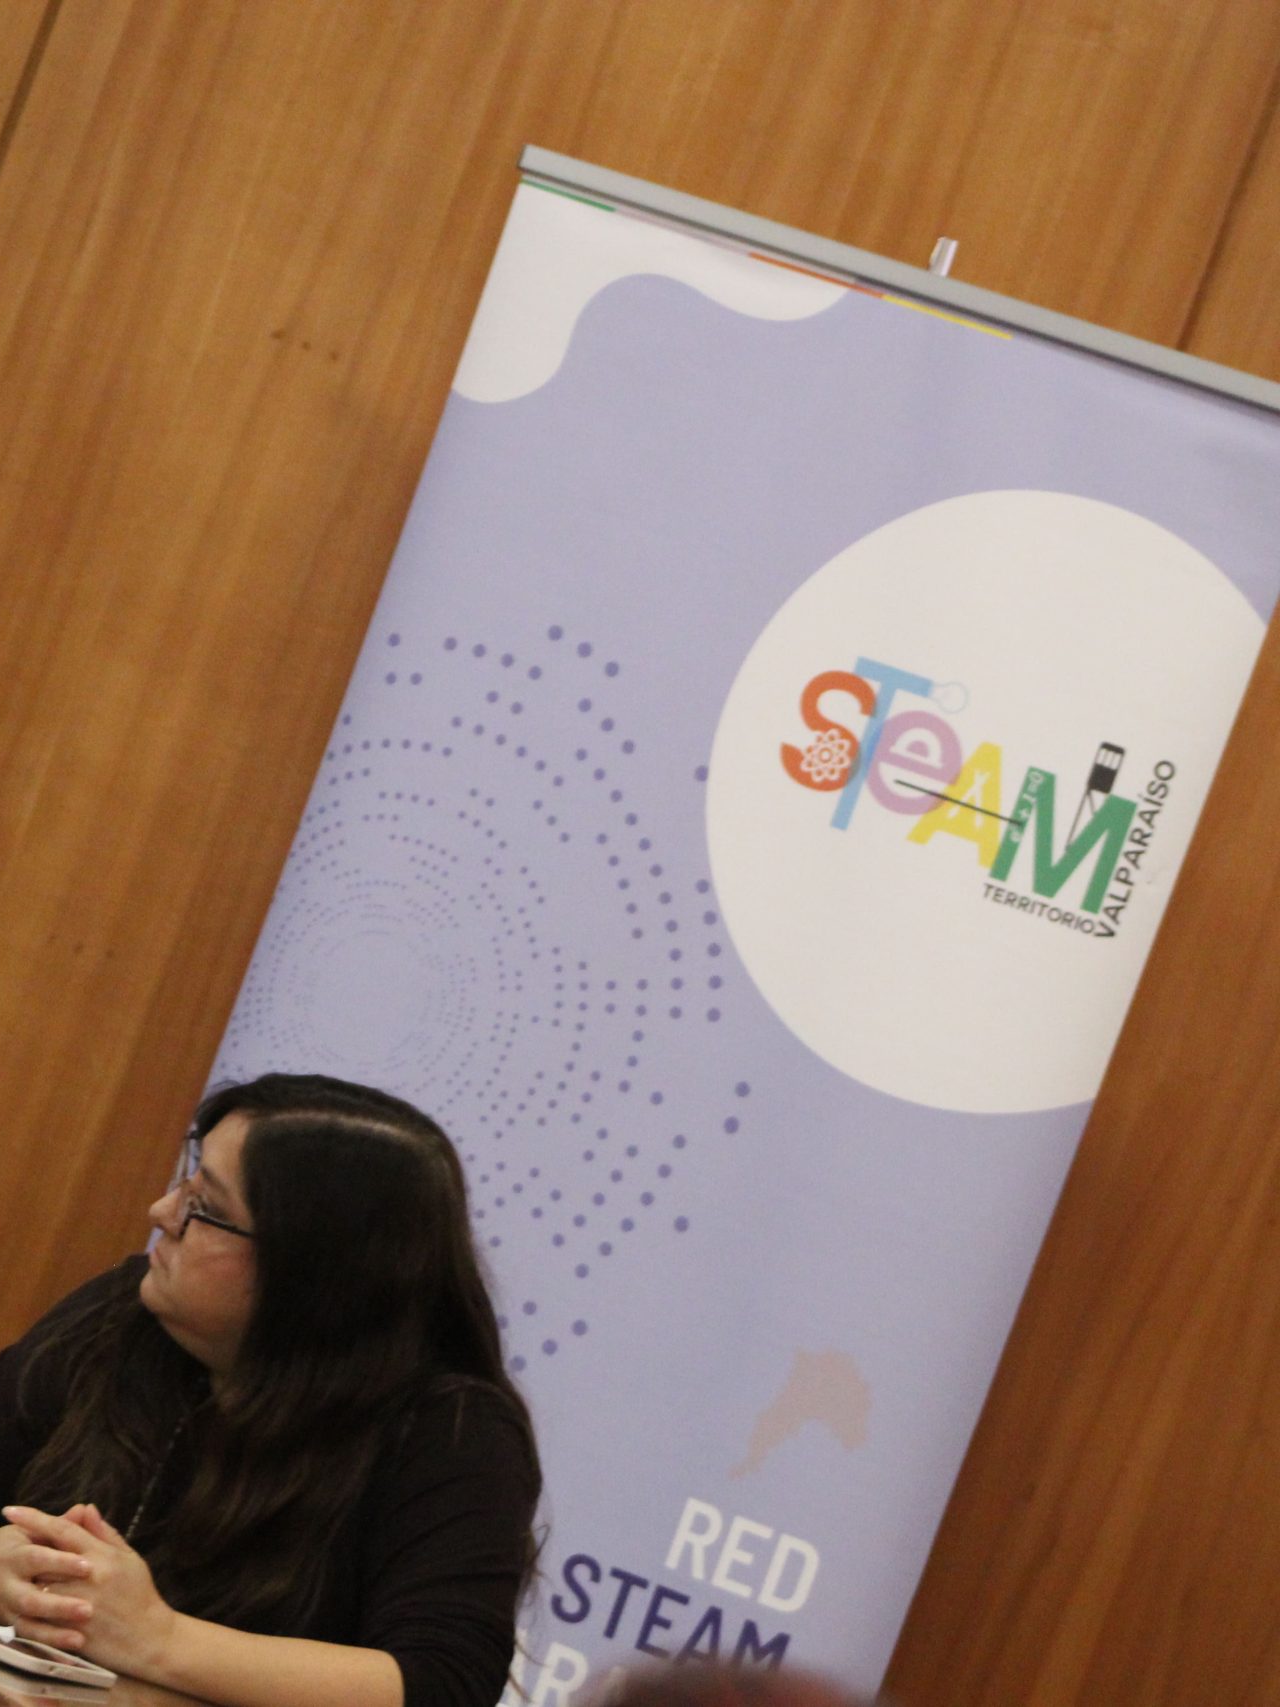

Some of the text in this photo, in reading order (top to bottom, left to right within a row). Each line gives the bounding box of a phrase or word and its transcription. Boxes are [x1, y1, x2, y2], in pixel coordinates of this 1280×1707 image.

[1093, 759, 1176, 939] VALPARAÍSO
[983, 882, 1096, 935] TERRITORIO
[550, 1553, 791, 1672] STEAM
[664, 1497, 819, 1613] RED
